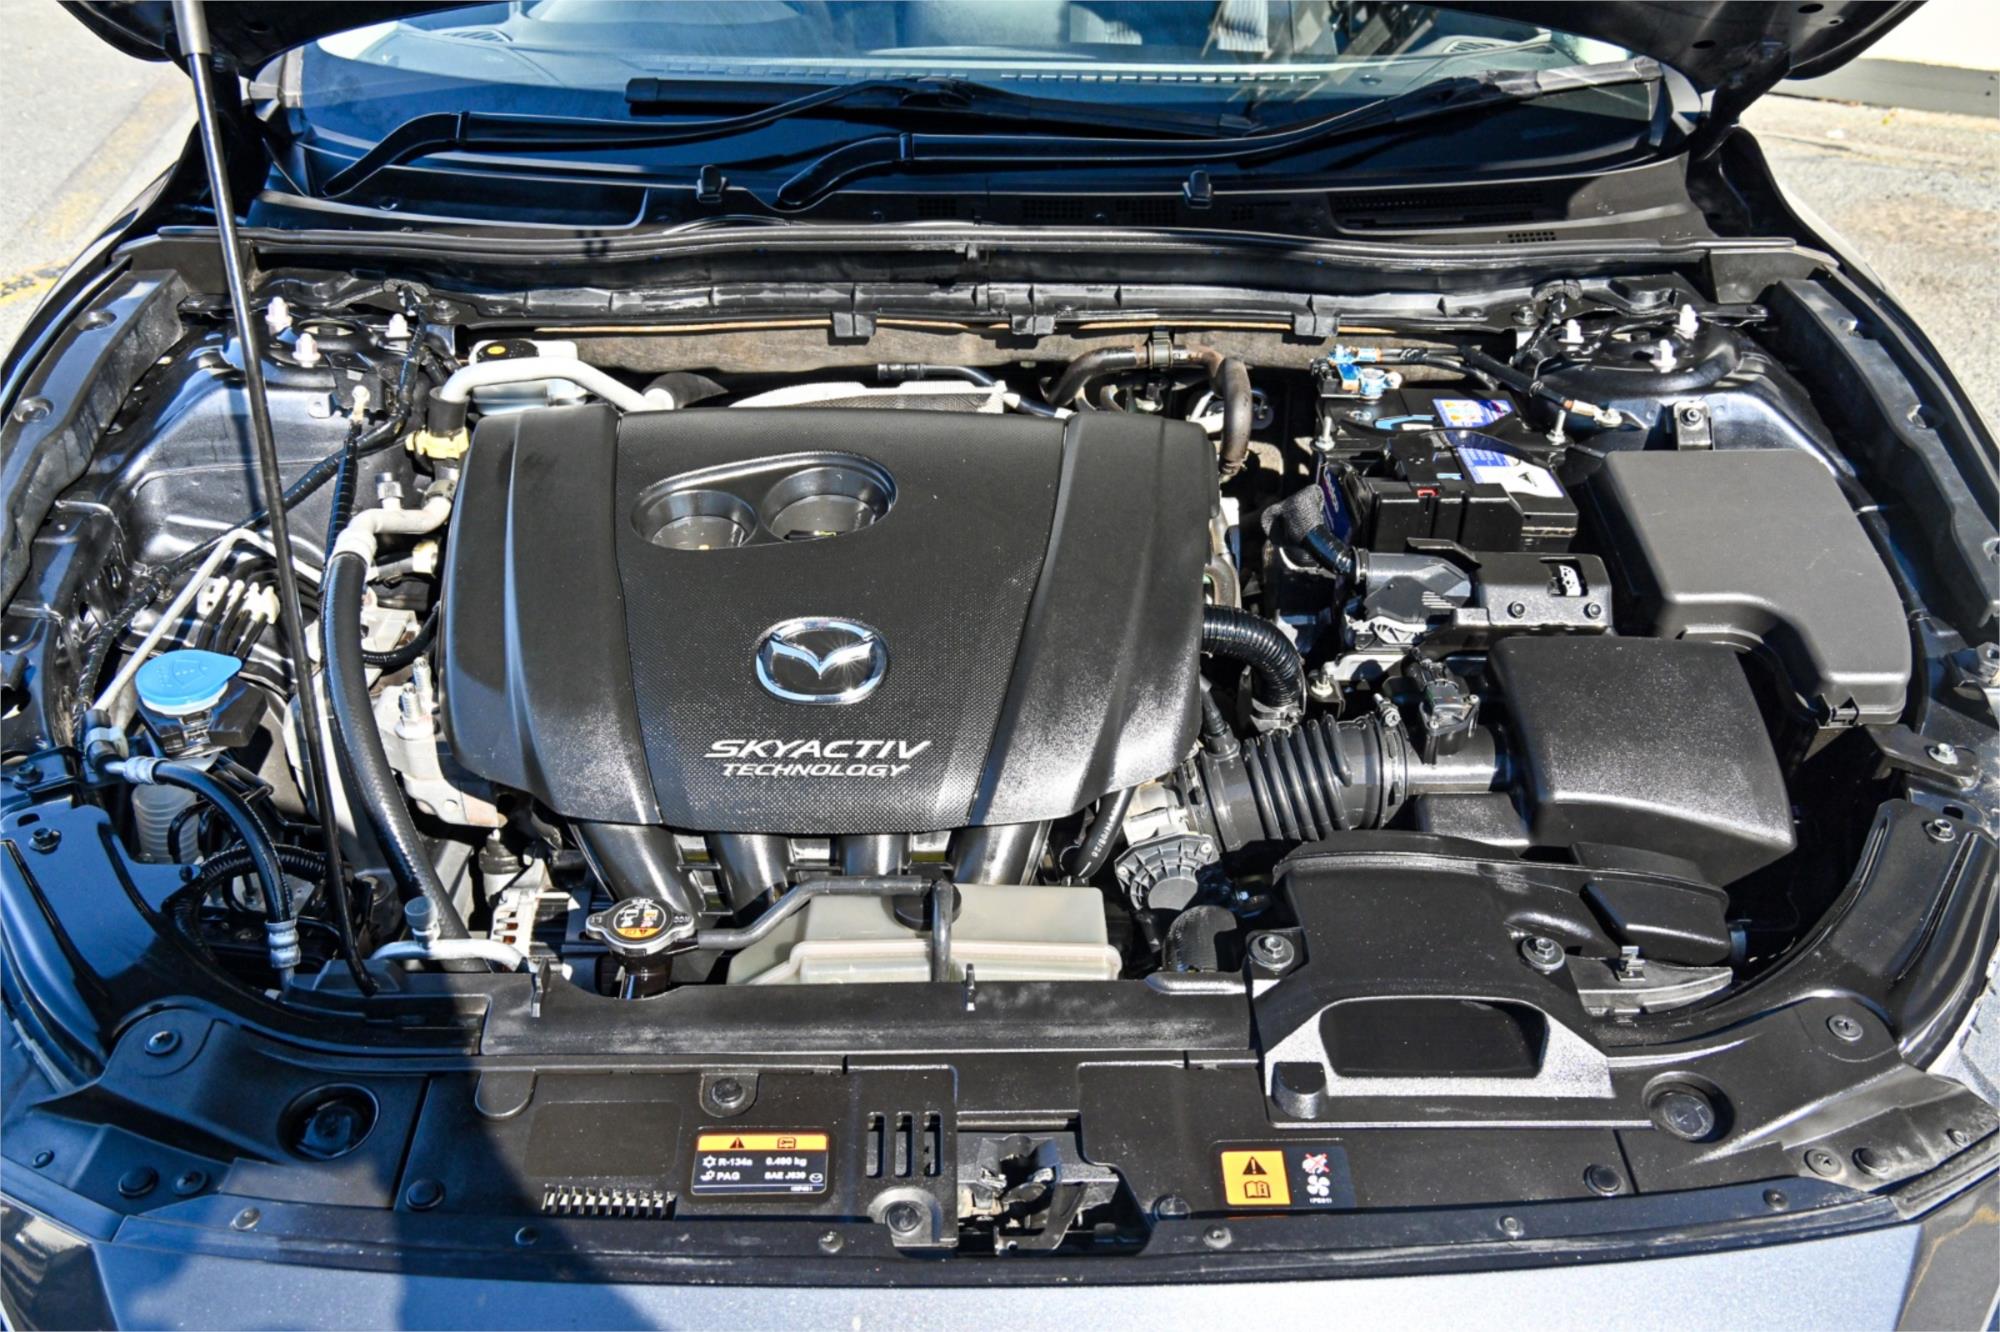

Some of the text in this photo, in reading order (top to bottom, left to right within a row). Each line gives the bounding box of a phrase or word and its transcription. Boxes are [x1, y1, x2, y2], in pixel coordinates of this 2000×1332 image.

[703, 740, 932, 759] SKYACTIV
[721, 763, 911, 777] TECHNOLOGY
[717, 1157, 753, 1166] R-134a
[794, 1156, 808, 1167] kg
